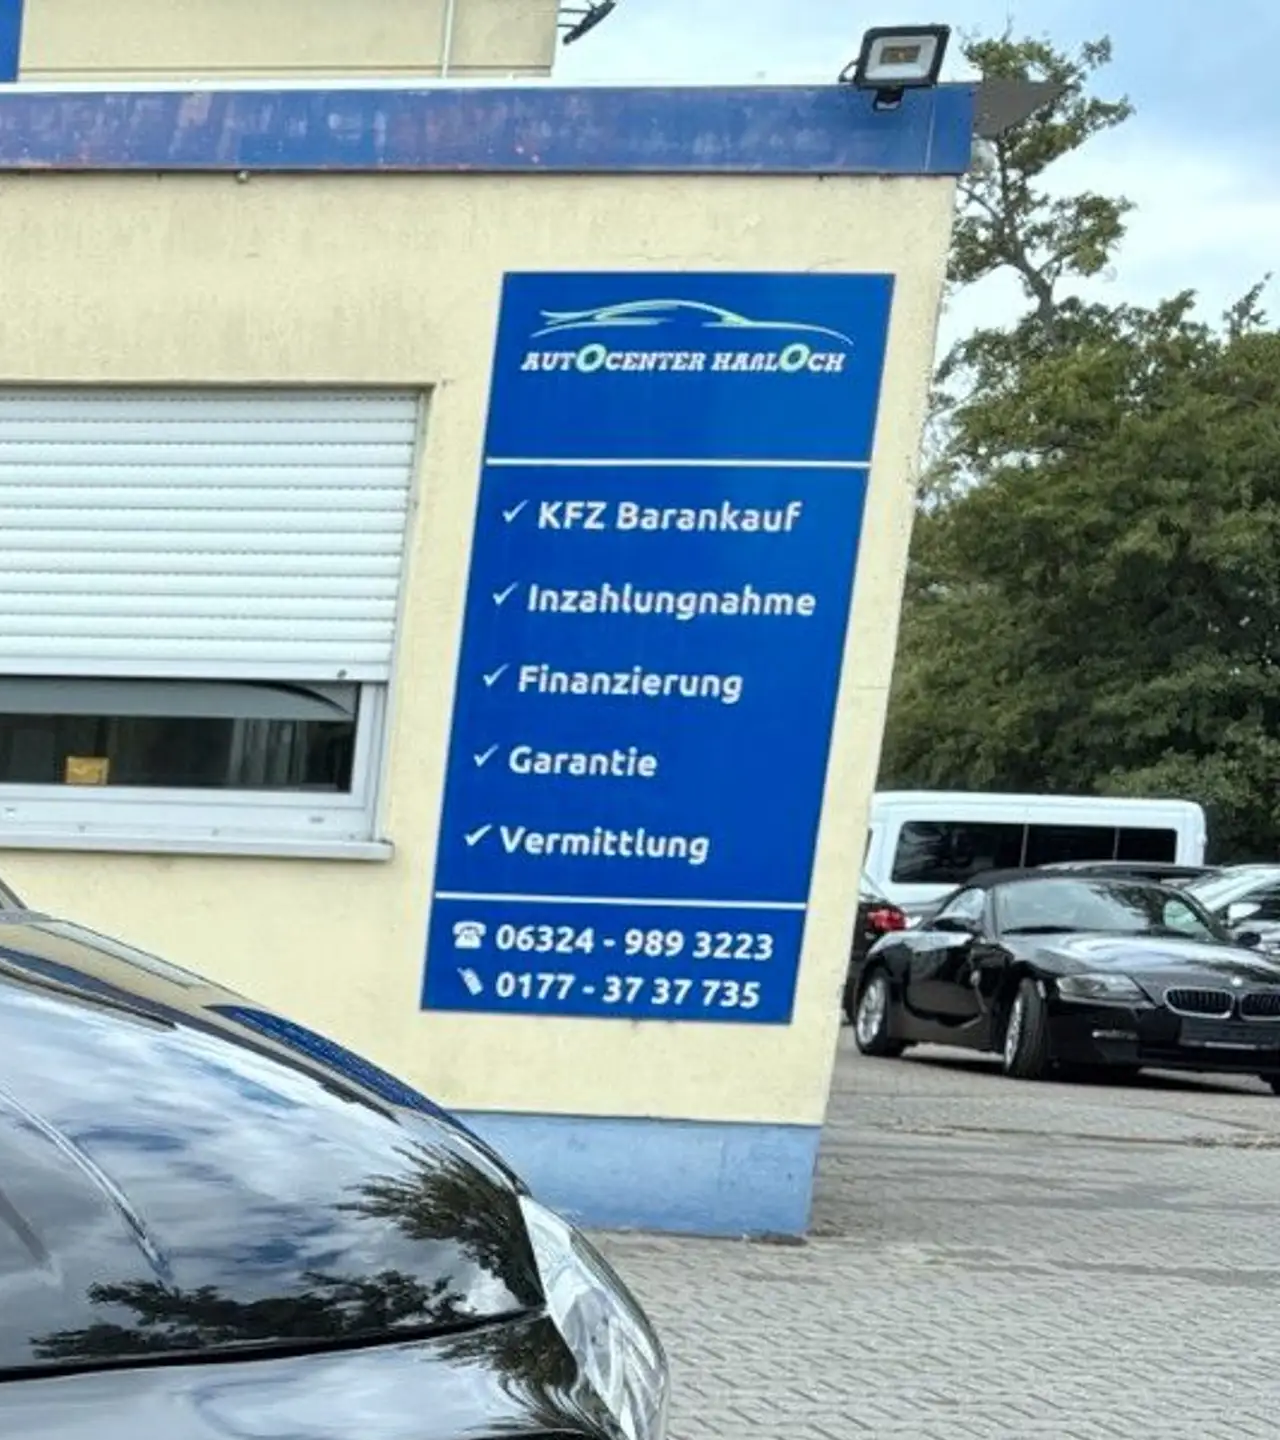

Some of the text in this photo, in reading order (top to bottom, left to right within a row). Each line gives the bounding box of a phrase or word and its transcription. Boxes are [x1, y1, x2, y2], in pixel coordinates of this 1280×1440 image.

[521, 343, 704, 372] AUTOCENTER
[538, 501, 802, 532] KFZ Barankauf
[528, 583, 816, 620] Inzahlungnahme
[518, 664, 743, 704] Finanzierung
[509, 746, 657, 777] Garantie
[500, 826, 709, 865] Vermittlung
[496, 924, 594, 953] 06324
[625, 928, 684, 957] 989
[693, 931, 773, 961] 3223
[496, 971, 575, 1000] 0177
[603, 976, 644, 1003] 37
[651, 978, 692, 1005] 37
[702, 979, 759, 1009] 735
